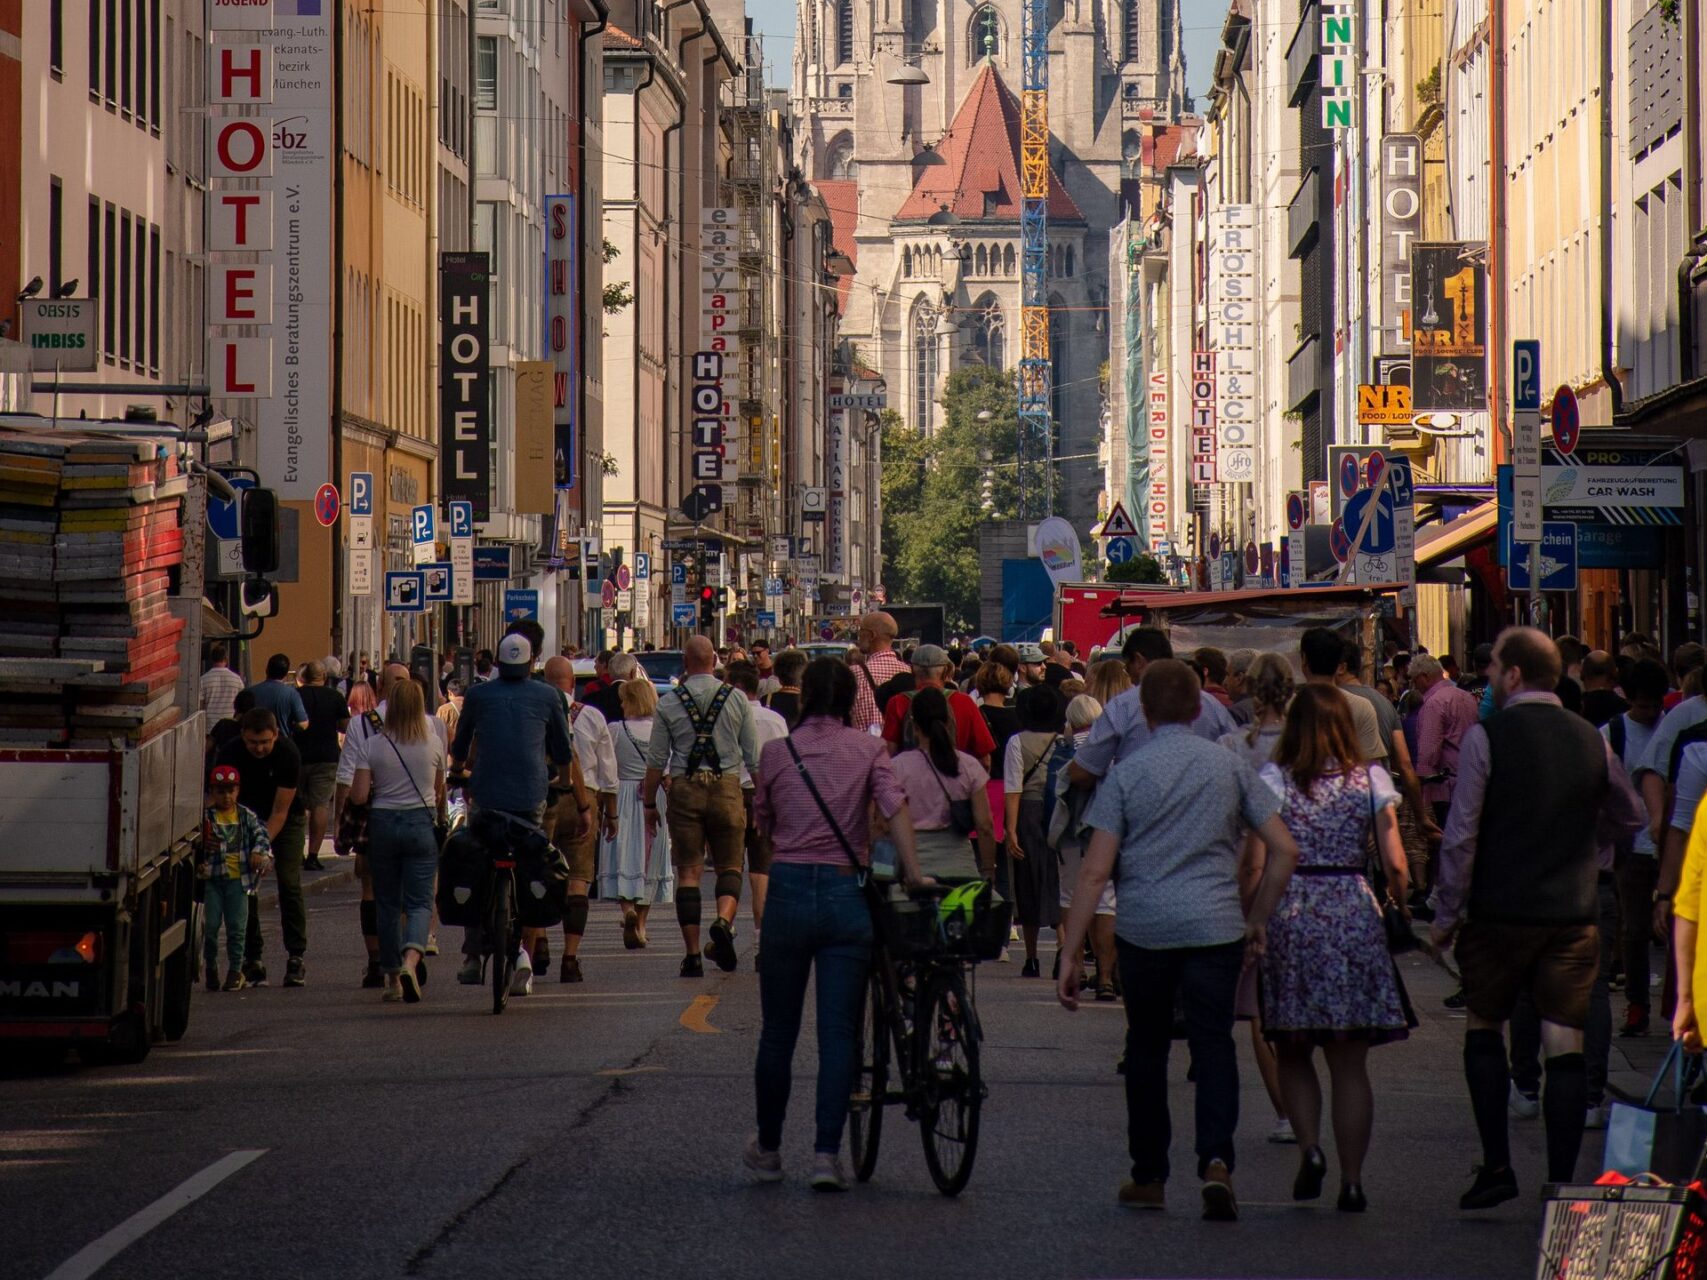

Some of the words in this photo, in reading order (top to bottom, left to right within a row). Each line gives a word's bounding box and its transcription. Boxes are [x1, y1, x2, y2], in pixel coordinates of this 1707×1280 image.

[273, 45, 323, 55] ekanats-
[278, 60, 311, 72] bezirk
[286, 184, 300, 213] e.V.
[217, 49, 265, 392] HOTEL
[285, 219, 304, 366] Beratungszentrum
[552, 203, 567, 408] SHOW
[38, 304, 80, 318] OASIS
[32, 333, 85, 349] IMBISS
[451, 296, 480, 479] HOTEL
[1517, 349, 1532, 401] P
[832, 396, 884, 407] HOTEL
[1151, 373, 1166, 454] VERDI
[1362, 412, 1386, 420] FOOD
[283, 371, 303, 483] Evangelisches
[1195, 355, 1211, 480] HOTEL
[832, 425, 842, 489] ATLAS
[353, 479, 366, 510] P
[1587, 487, 1613, 497] CAR
[1617, 487, 1656, 497] WASH
[415, 510, 428, 539] P
[453, 507, 466, 533] P
[636, 556, 645, 576] P
[673, 566, 682, 582] P
[1368, 574, 1384, 582] frei
